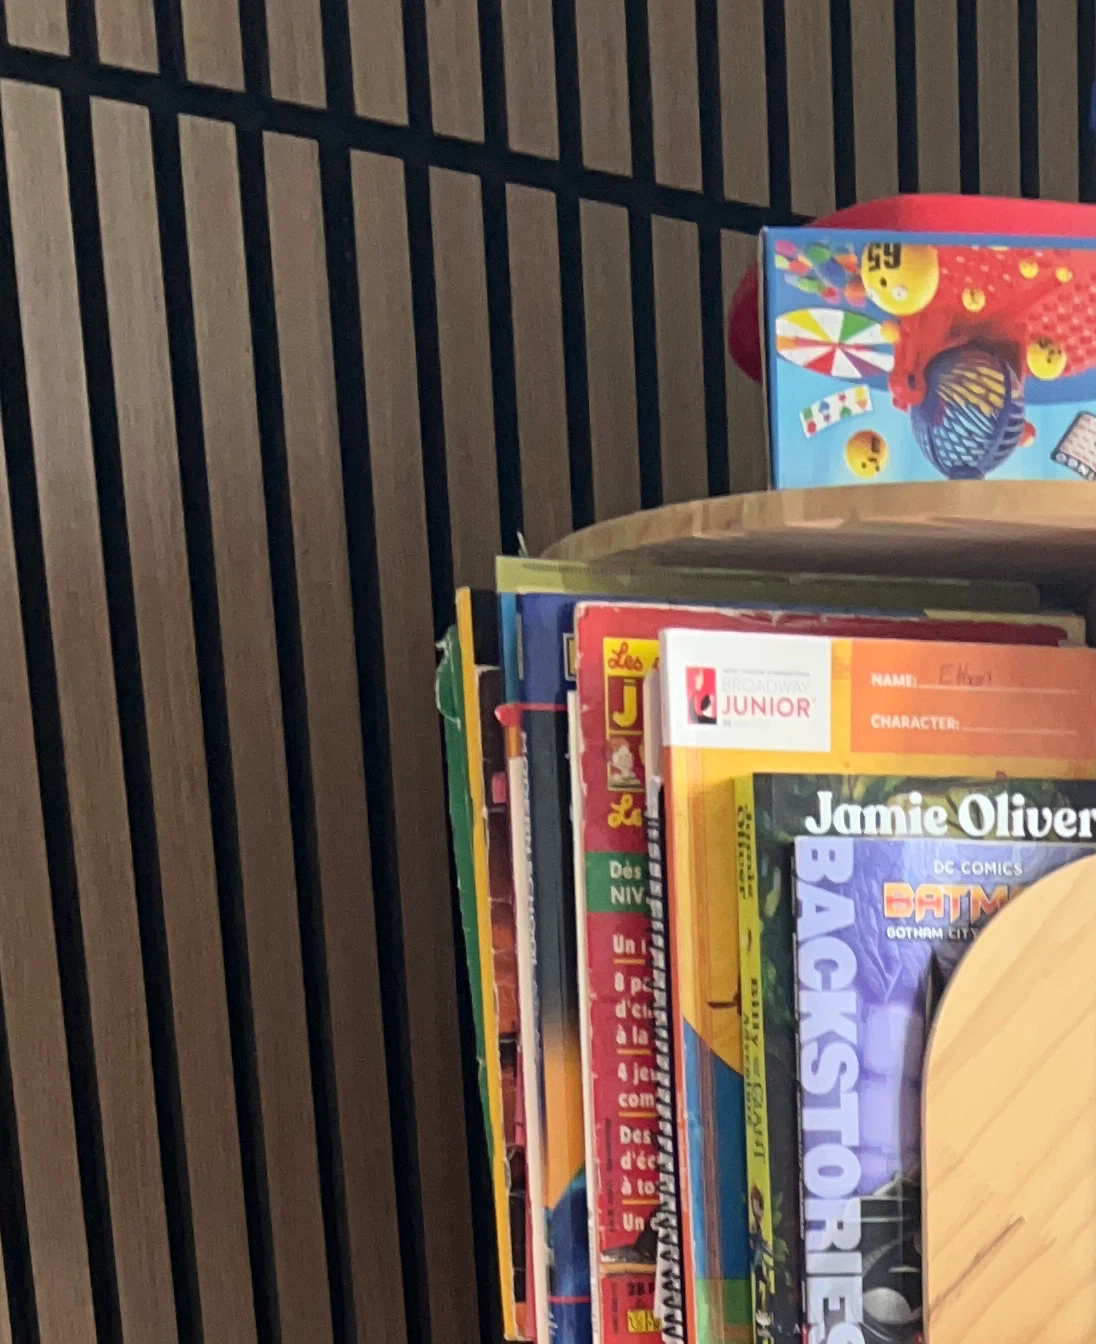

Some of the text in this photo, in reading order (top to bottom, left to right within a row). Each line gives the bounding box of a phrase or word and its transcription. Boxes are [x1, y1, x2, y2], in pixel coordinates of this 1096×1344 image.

[871, 673, 918, 689] NAME:
[722, 695, 812, 719] JUNIOR
[870, 714, 961, 731] CHARACTER:
[805, 790, 948, 836] Jamie
[934, 860, 1023, 877] DC COMICS
[883, 882, 1010, 923] BATM
[887, 926, 944, 940] GOTHAM
[612, 934, 636, 955] Un
[632, 1025, 649, 1045] la
